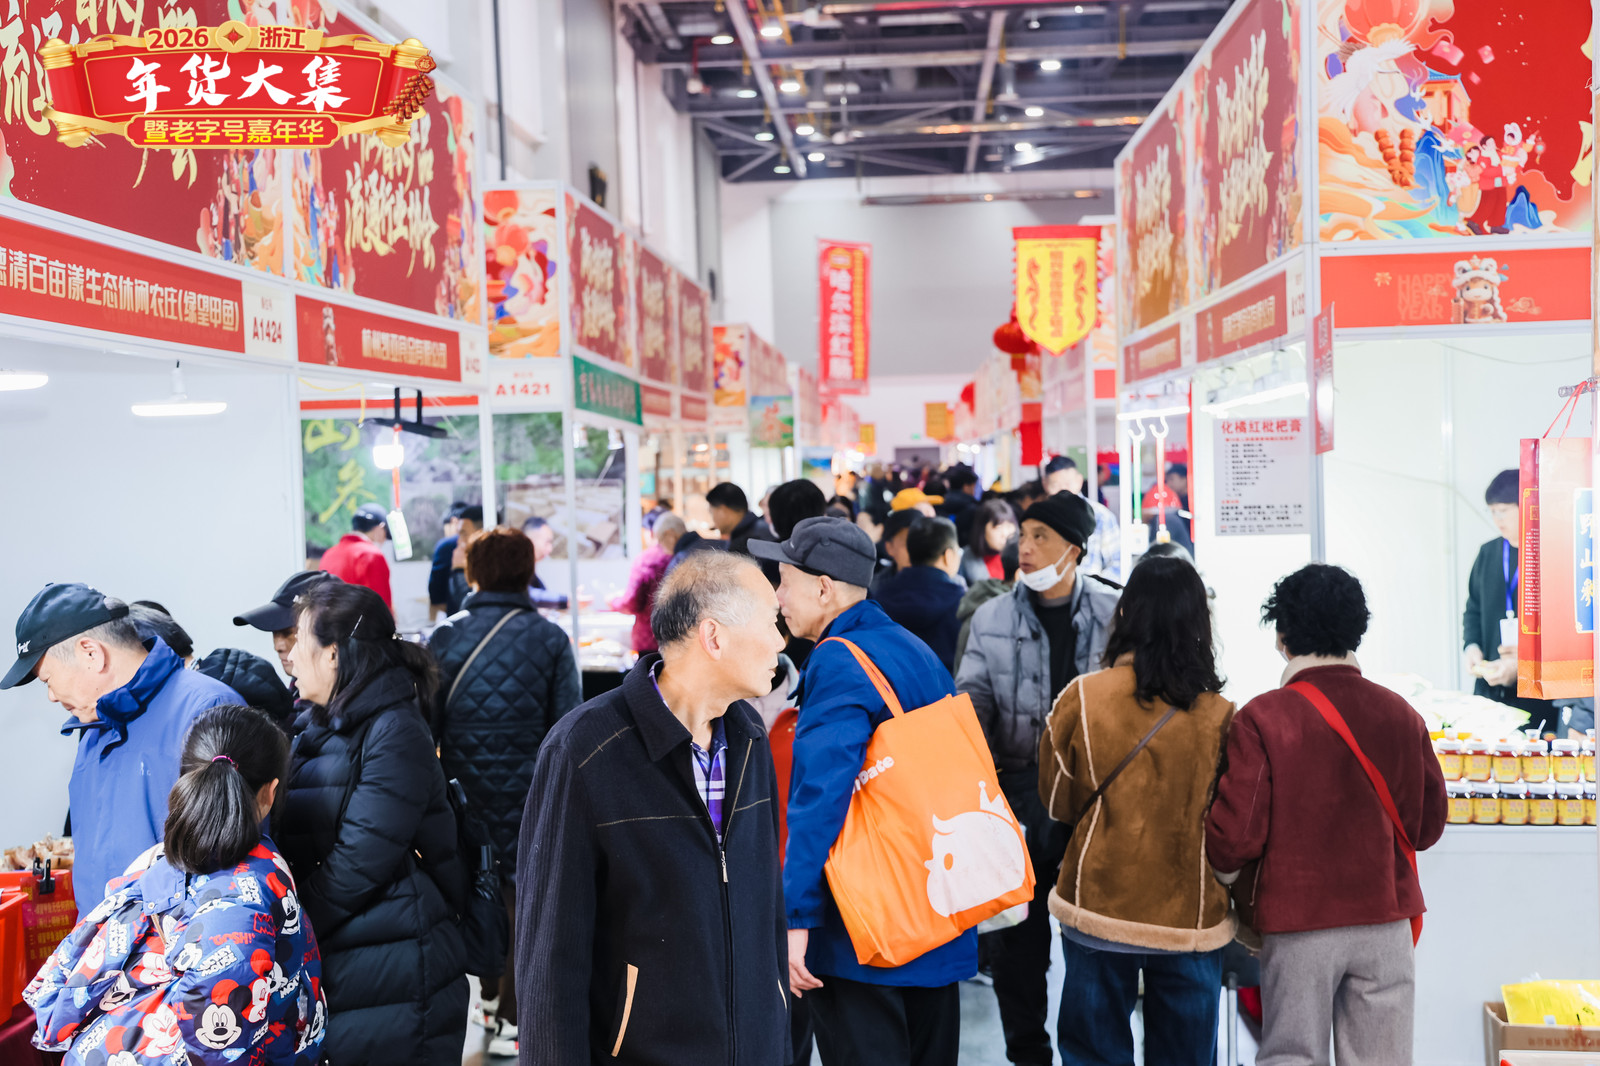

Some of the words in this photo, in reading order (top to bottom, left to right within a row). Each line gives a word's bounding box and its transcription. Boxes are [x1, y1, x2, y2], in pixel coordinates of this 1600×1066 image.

[1397, 303, 1444, 321] YEAR
[252, 316, 283, 344] A1424
[496, 383, 551, 396] A1421
